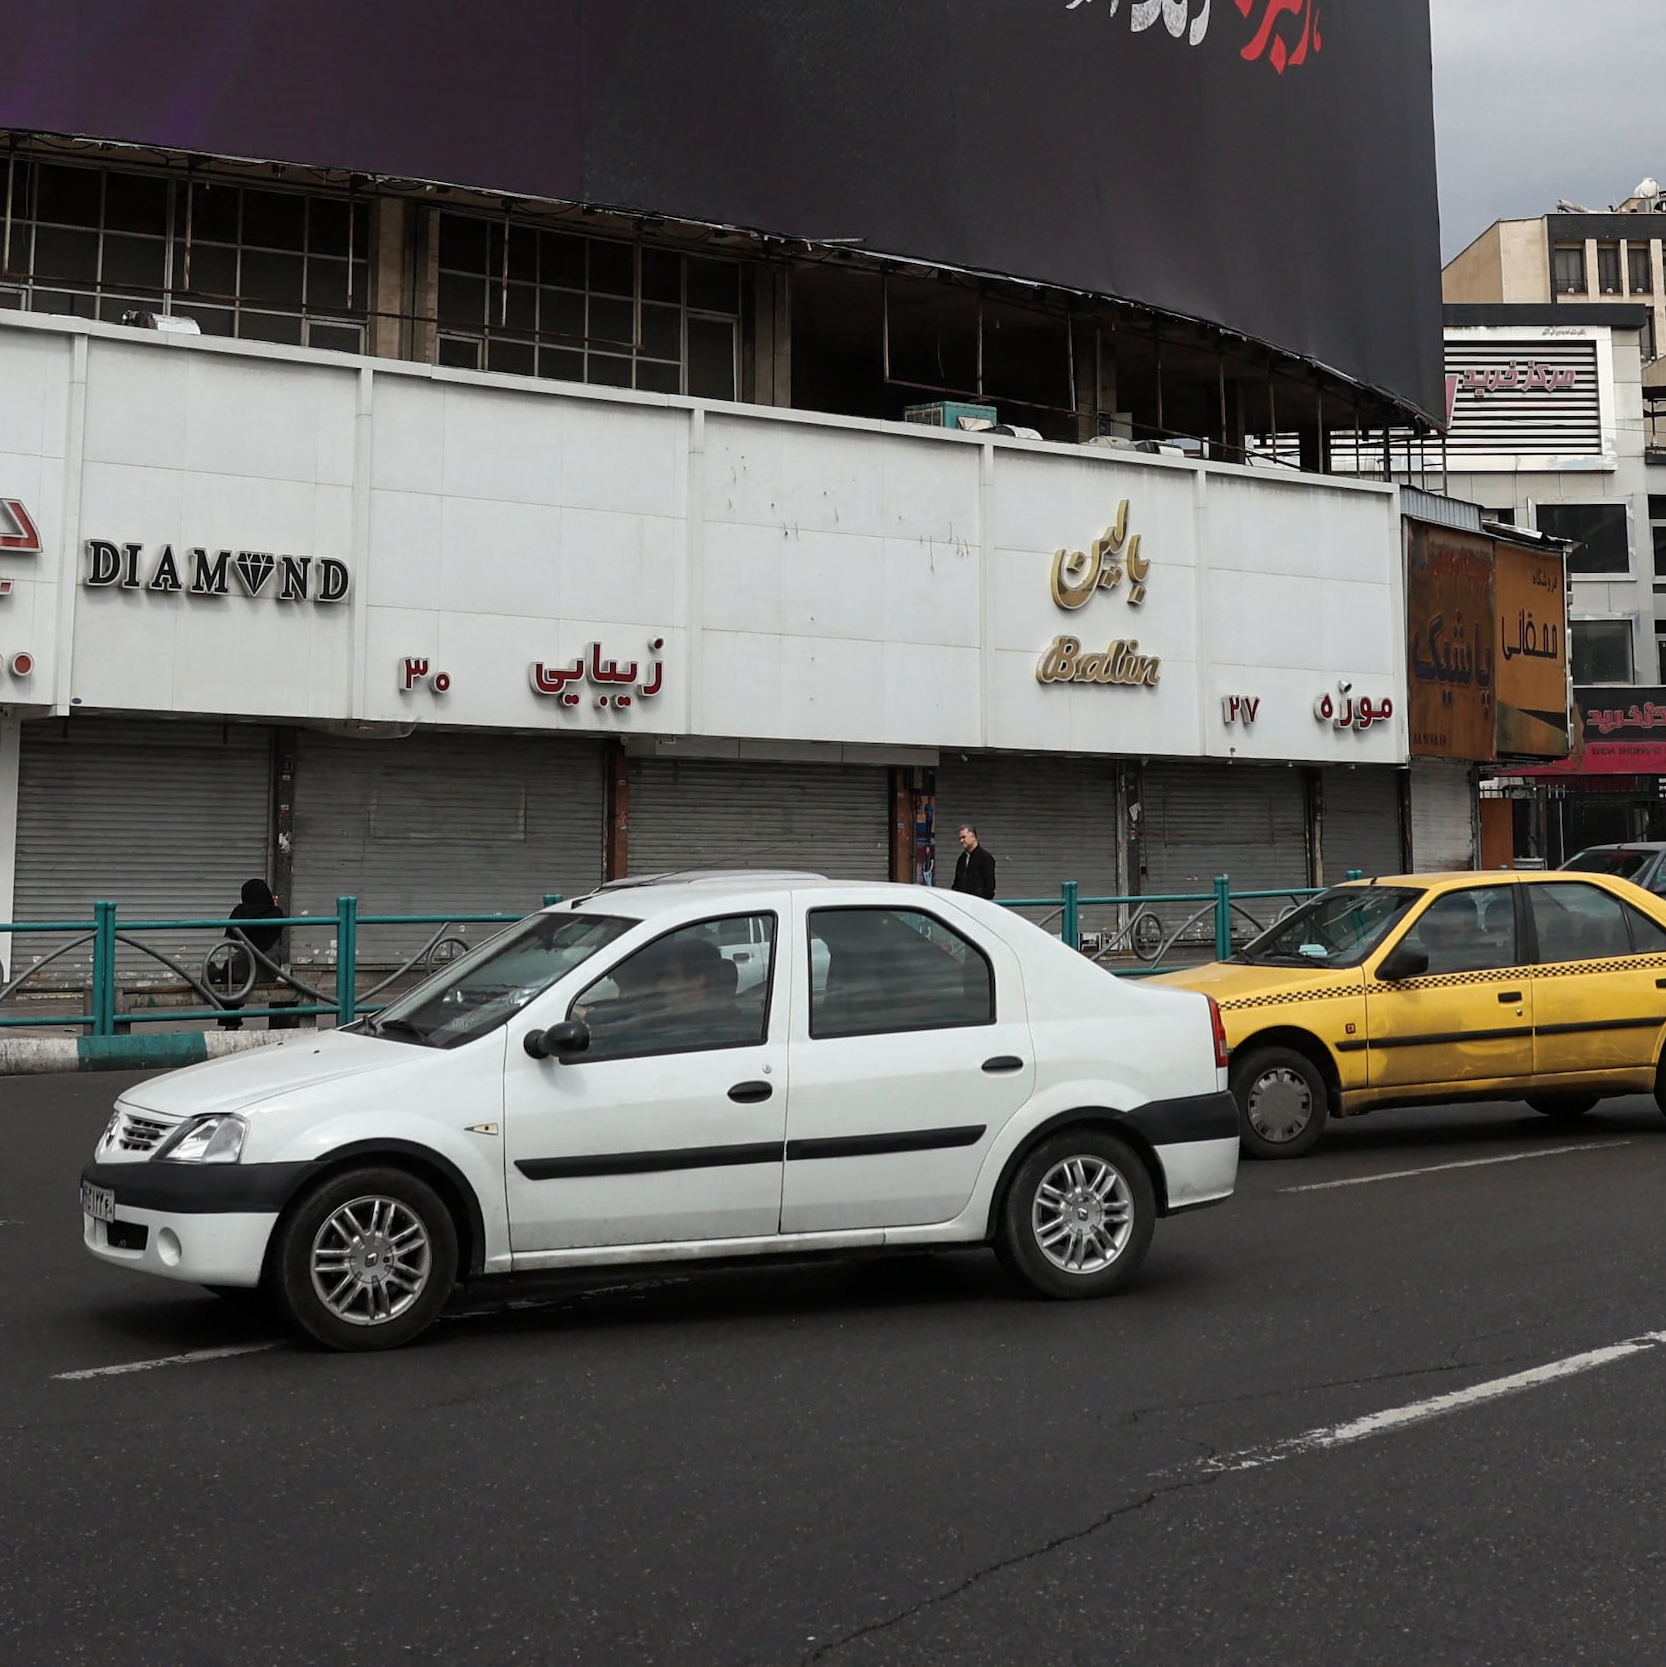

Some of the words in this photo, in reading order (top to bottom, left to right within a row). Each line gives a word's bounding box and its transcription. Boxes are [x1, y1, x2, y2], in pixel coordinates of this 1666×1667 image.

[1462, 360, 1520, 398] خرید
[1520, 360, 1576, 392] مرکز
[1050, 498, 1151, 610] بالین
[531, 637, 664, 709] زیبایی
[1036, 635, 1162, 690] Balin
[1314, 681, 1394, 730] موزه
[1587, 705, 1643, 733] خرید
